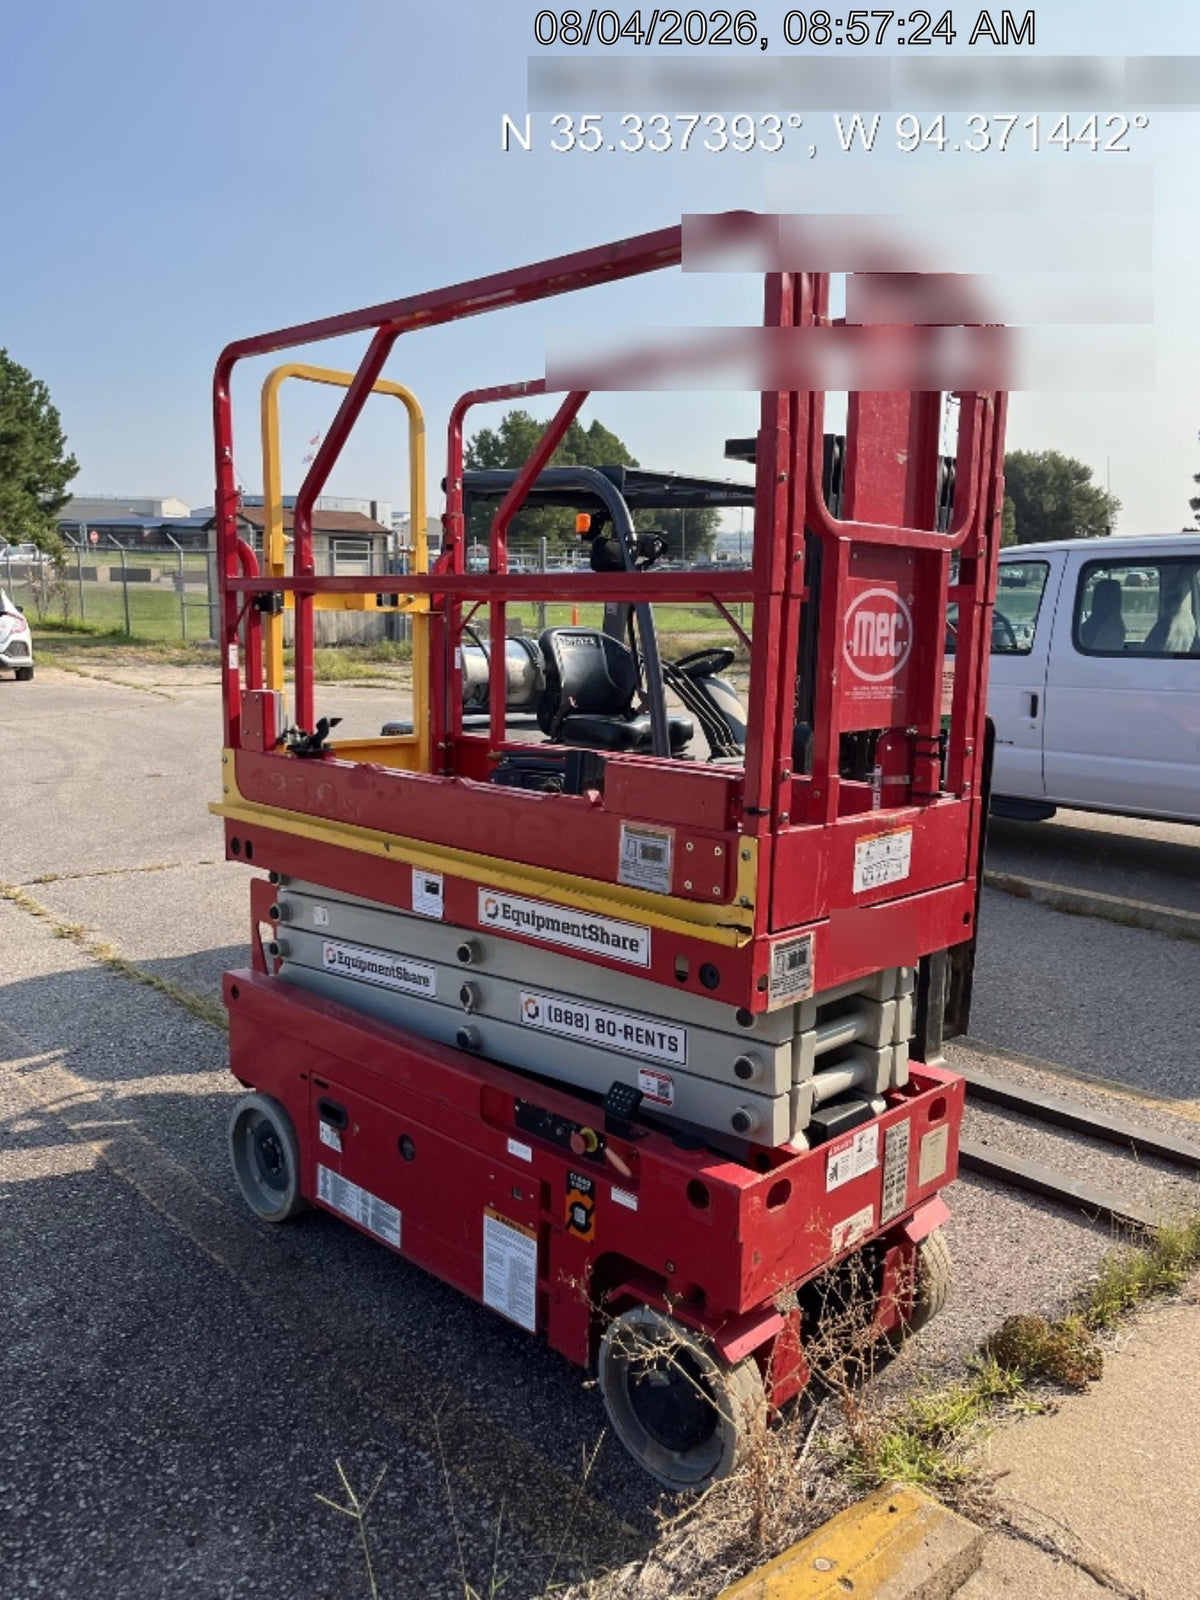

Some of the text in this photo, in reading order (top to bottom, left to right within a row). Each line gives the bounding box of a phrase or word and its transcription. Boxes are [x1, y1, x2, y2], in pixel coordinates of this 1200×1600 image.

[500, 902, 640, 953] EquipmentShare
[337, 950, 431, 988] EquipmentShare
[547, 1004, 679, 1053] (888) 80-RENTS
